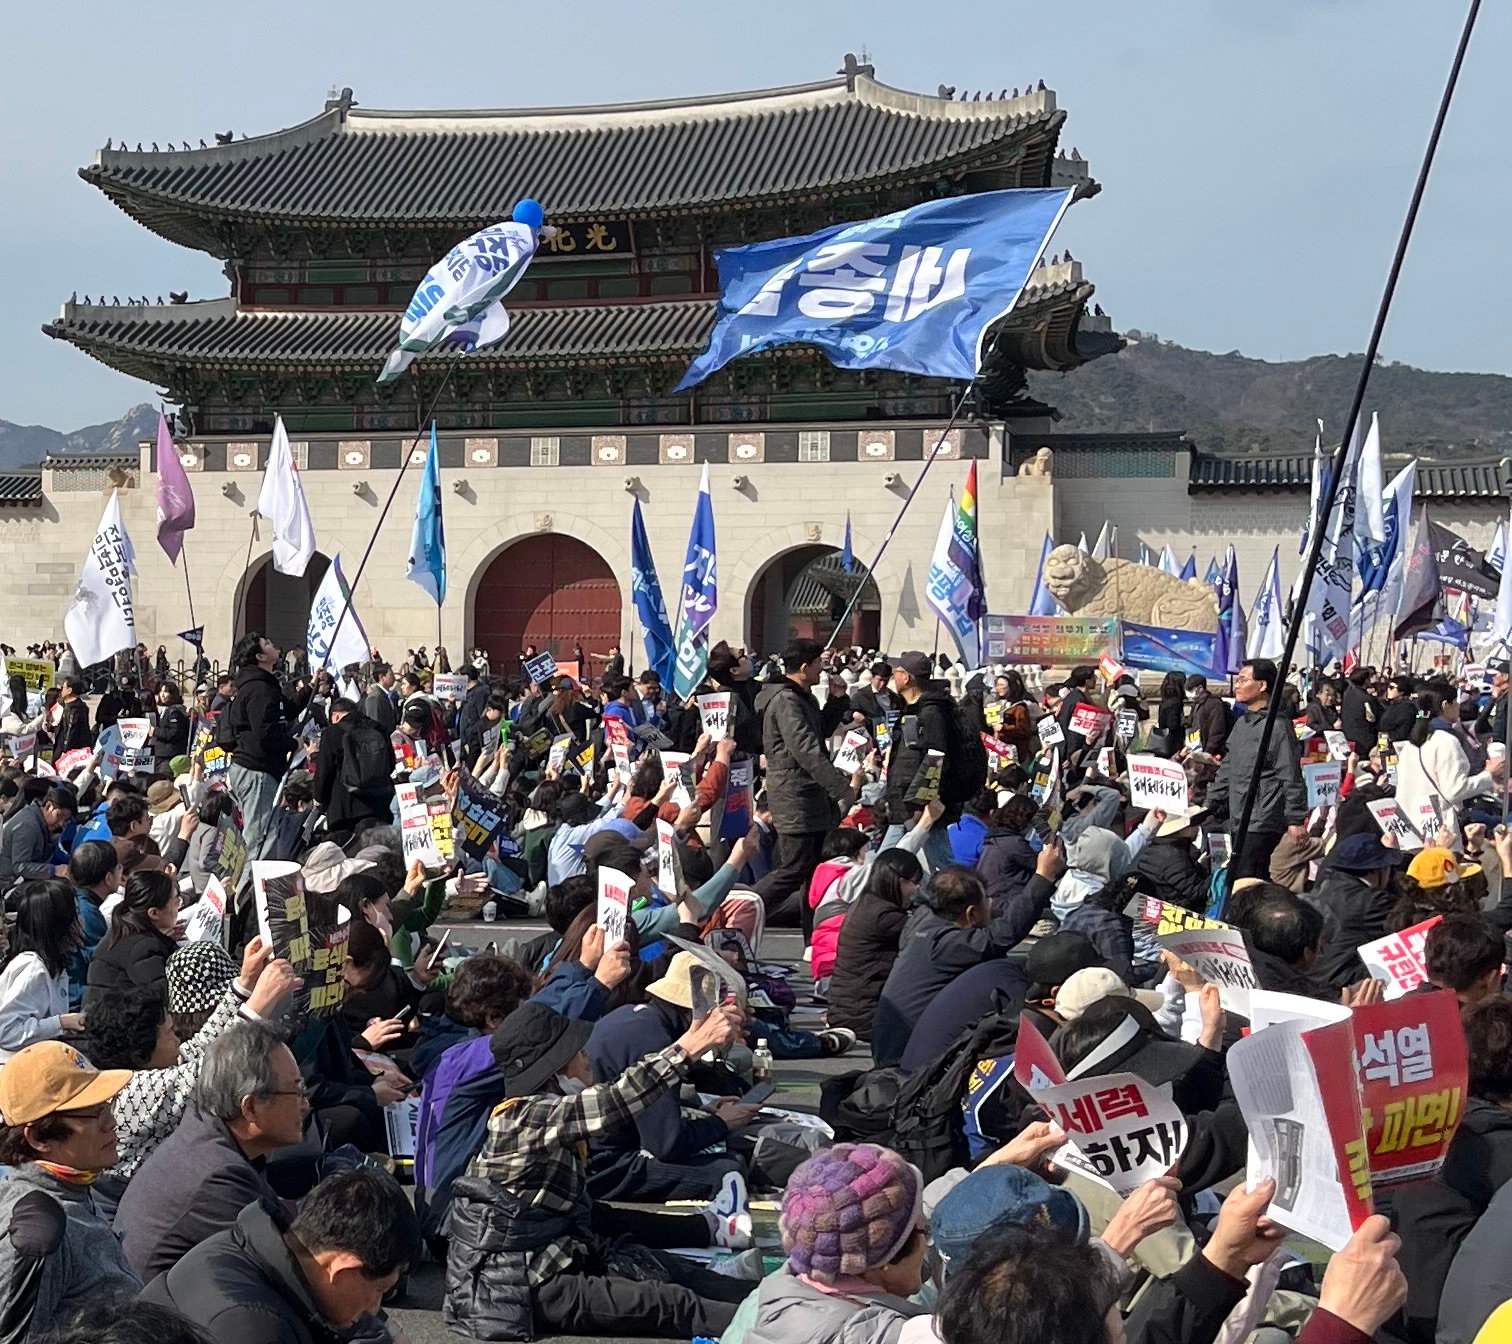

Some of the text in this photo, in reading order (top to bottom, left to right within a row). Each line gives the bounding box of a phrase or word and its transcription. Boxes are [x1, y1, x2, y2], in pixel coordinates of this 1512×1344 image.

[544, 223, 617, 252] 光化
[1360, 1022, 1434, 1088] 석열
[1084, 1118, 1185, 1178] 하자!
[1374, 1086, 1462, 1156] 파면!
